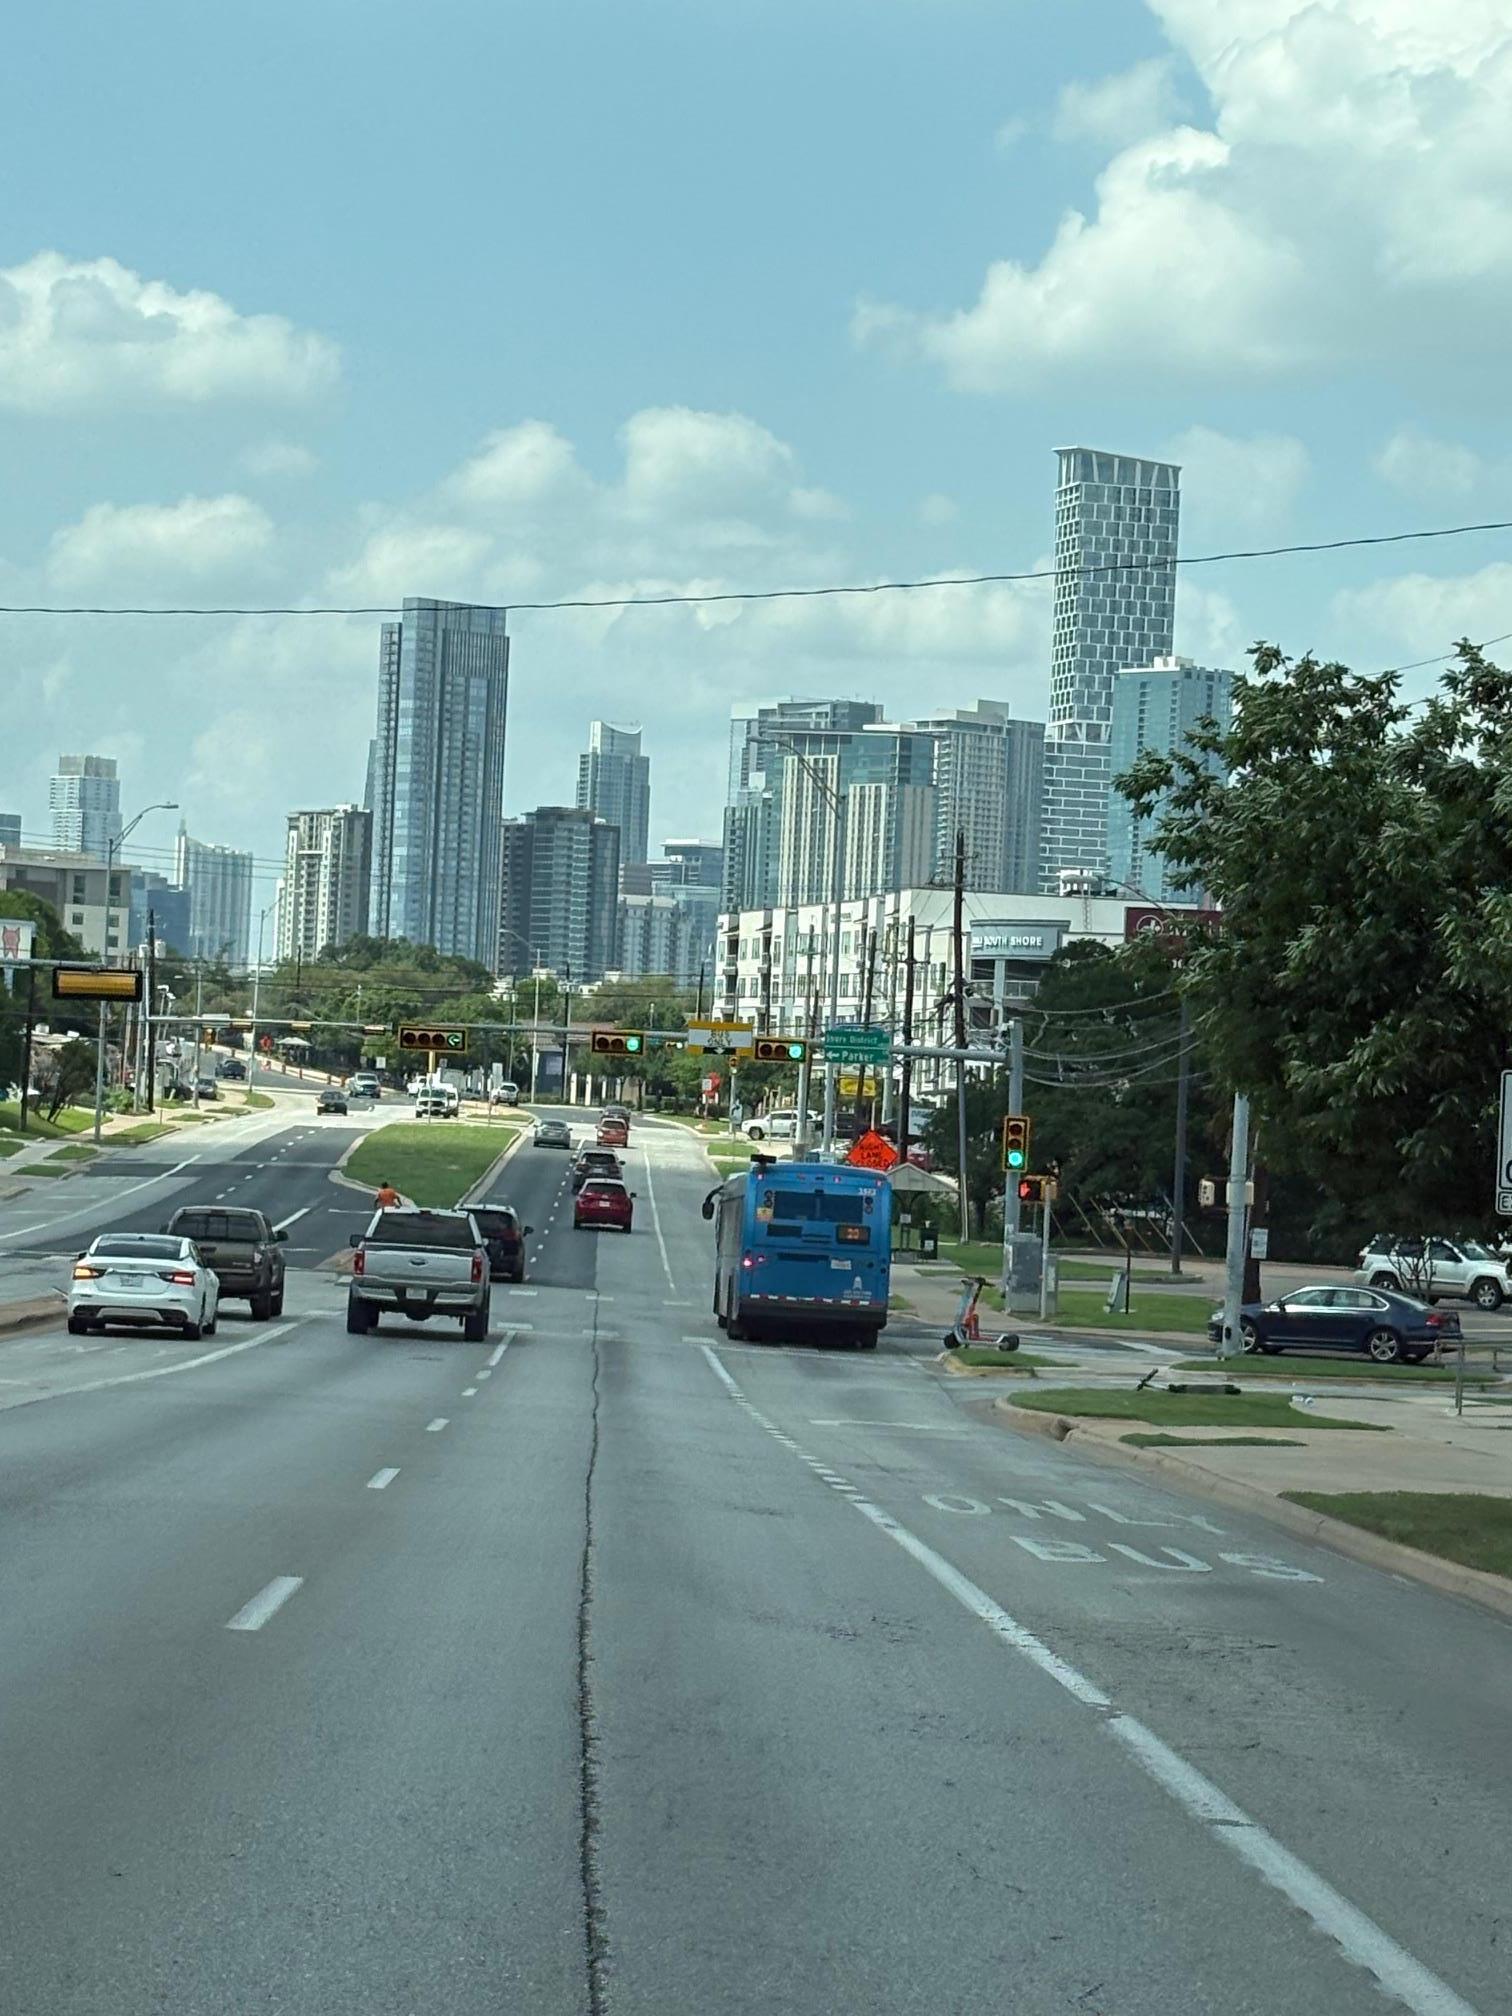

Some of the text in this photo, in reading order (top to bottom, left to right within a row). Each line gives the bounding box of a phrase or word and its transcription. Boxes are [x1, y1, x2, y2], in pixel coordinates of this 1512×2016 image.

[1010, 936, 1042, 946] SHORE
[841, 1050, 874, 1062] Parker
[922, 1494, 1227, 1534] ONLY
[1008, 1535, 1326, 1583] BUS
